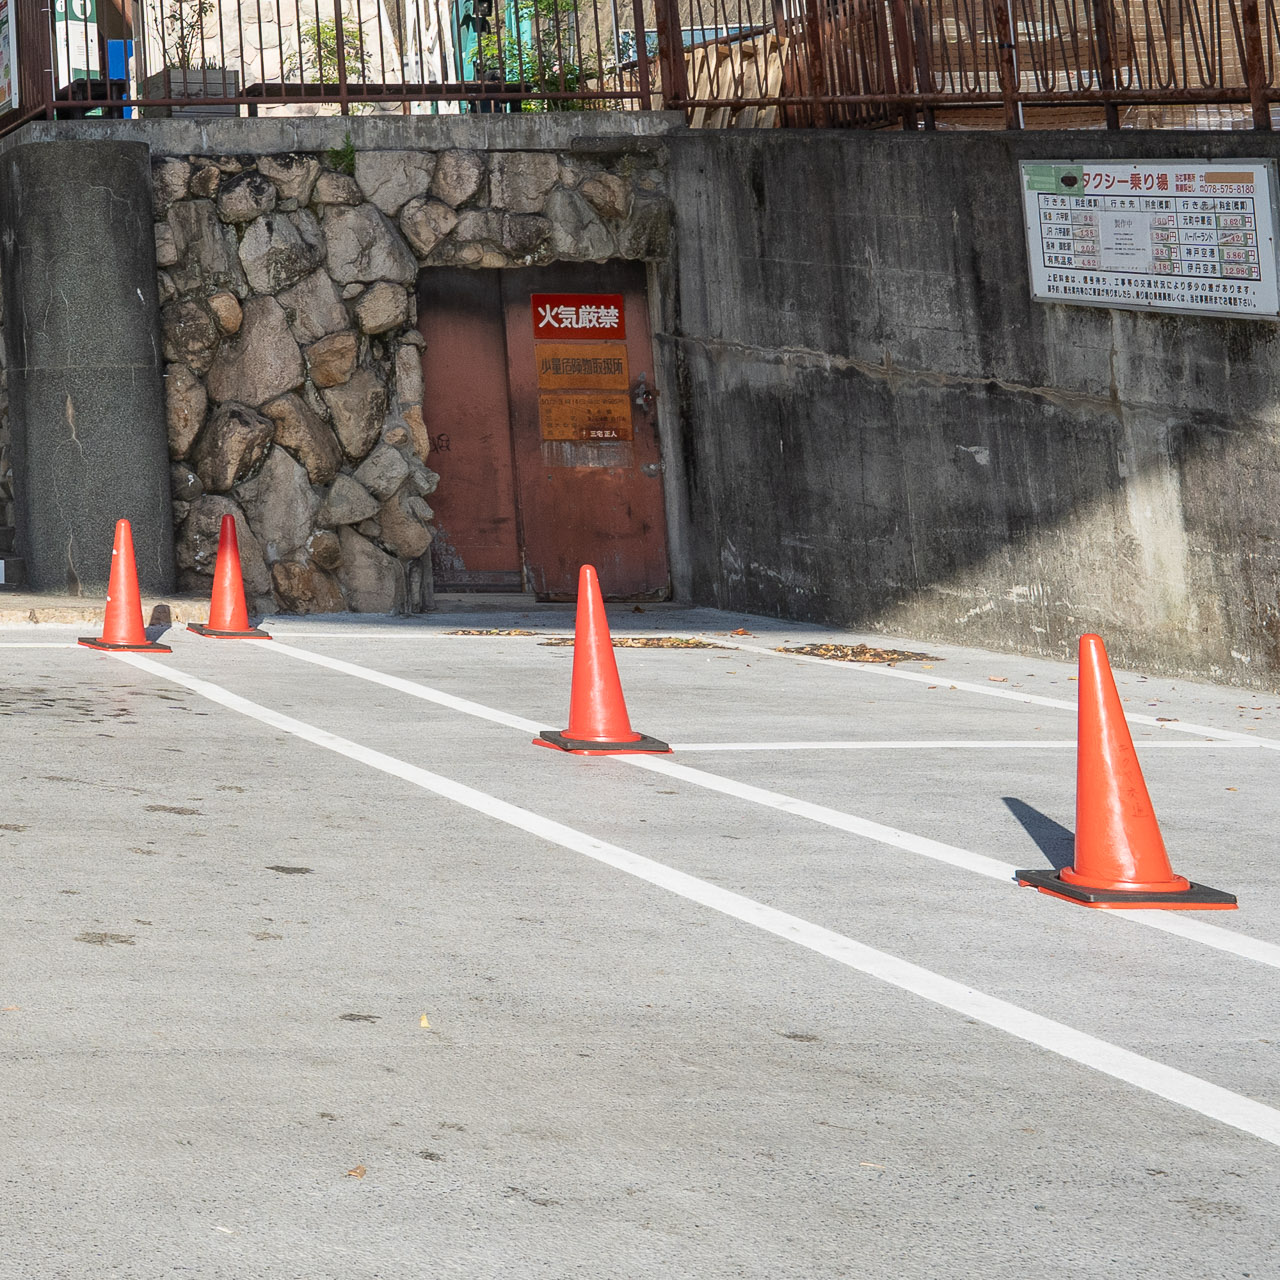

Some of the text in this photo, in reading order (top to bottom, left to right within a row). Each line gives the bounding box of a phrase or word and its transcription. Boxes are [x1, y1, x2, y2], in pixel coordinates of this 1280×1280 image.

[1082, 172, 1169, 191] タクシー乗り場
[1205, 184, 1255, 194] 078-575-8180
[1043, 196, 1067, 207] 行き先
[1110, 199, 1136, 209] 行き先
[1184, 232, 1214, 242] ハーバーランド
[1185, 248, 1216, 259] 神戸空港
[1187, 263, 1217, 274] 伊丹空港
[537, 303, 620, 329] 火気厳禁
